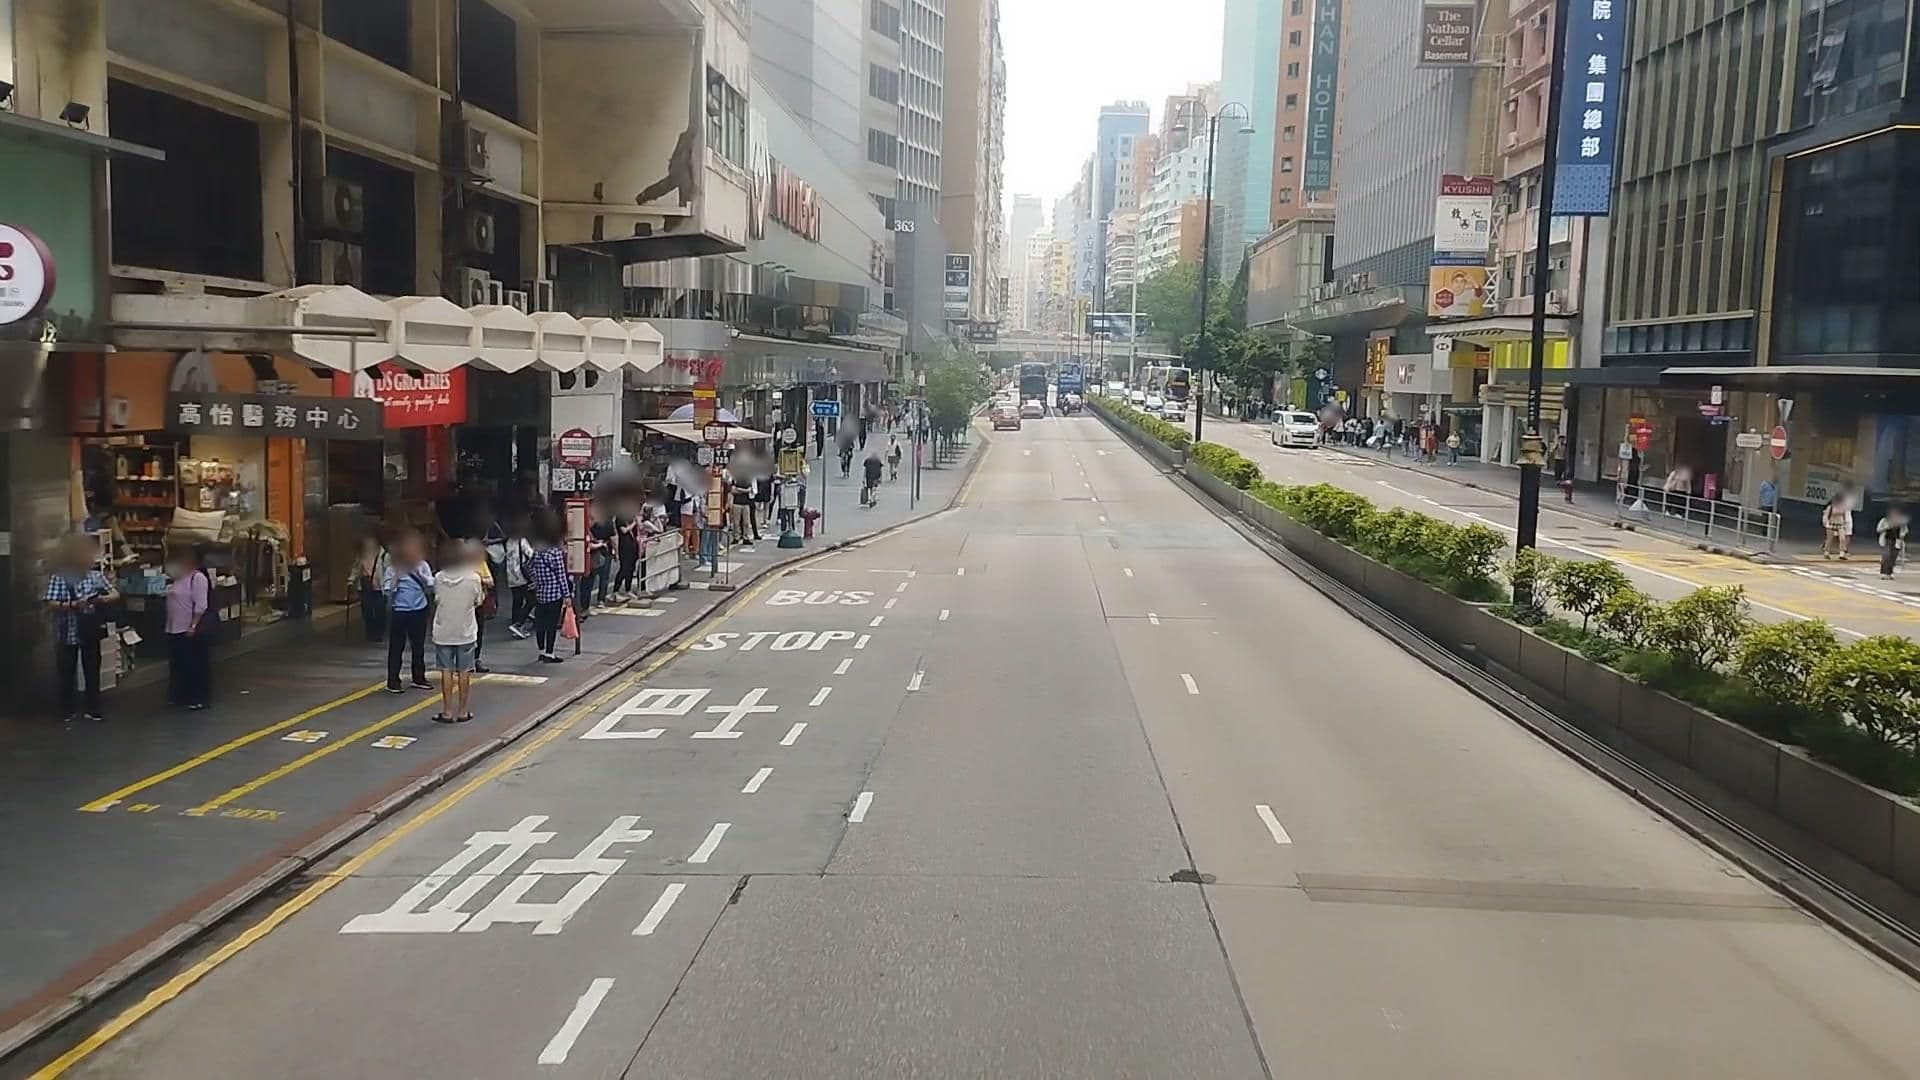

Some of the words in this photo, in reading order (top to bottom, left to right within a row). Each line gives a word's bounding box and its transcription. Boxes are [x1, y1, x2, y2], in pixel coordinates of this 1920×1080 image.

[1438, 10, 1461, 21] The
[1319, 0, 1336, 55] HAN
[1426, 23, 1470, 35] Nathan
[1430, 35, 1464, 46] Cellar
[1424, 50, 1468, 60] Basement
[1312, 73, 1332, 155] HOTEL
[1443, 185, 1491, 194] KYUSHIN
[894, 219, 915, 232] 363
[178, 402, 361, 430] 高怡醫務中心
[578, 471, 597, 481] YT
[765, 590, 875, 606] BUS
[690, 631, 856, 651] STOP
[579, 687, 779, 740] 巴士
[338, 815, 653, 935] 站
